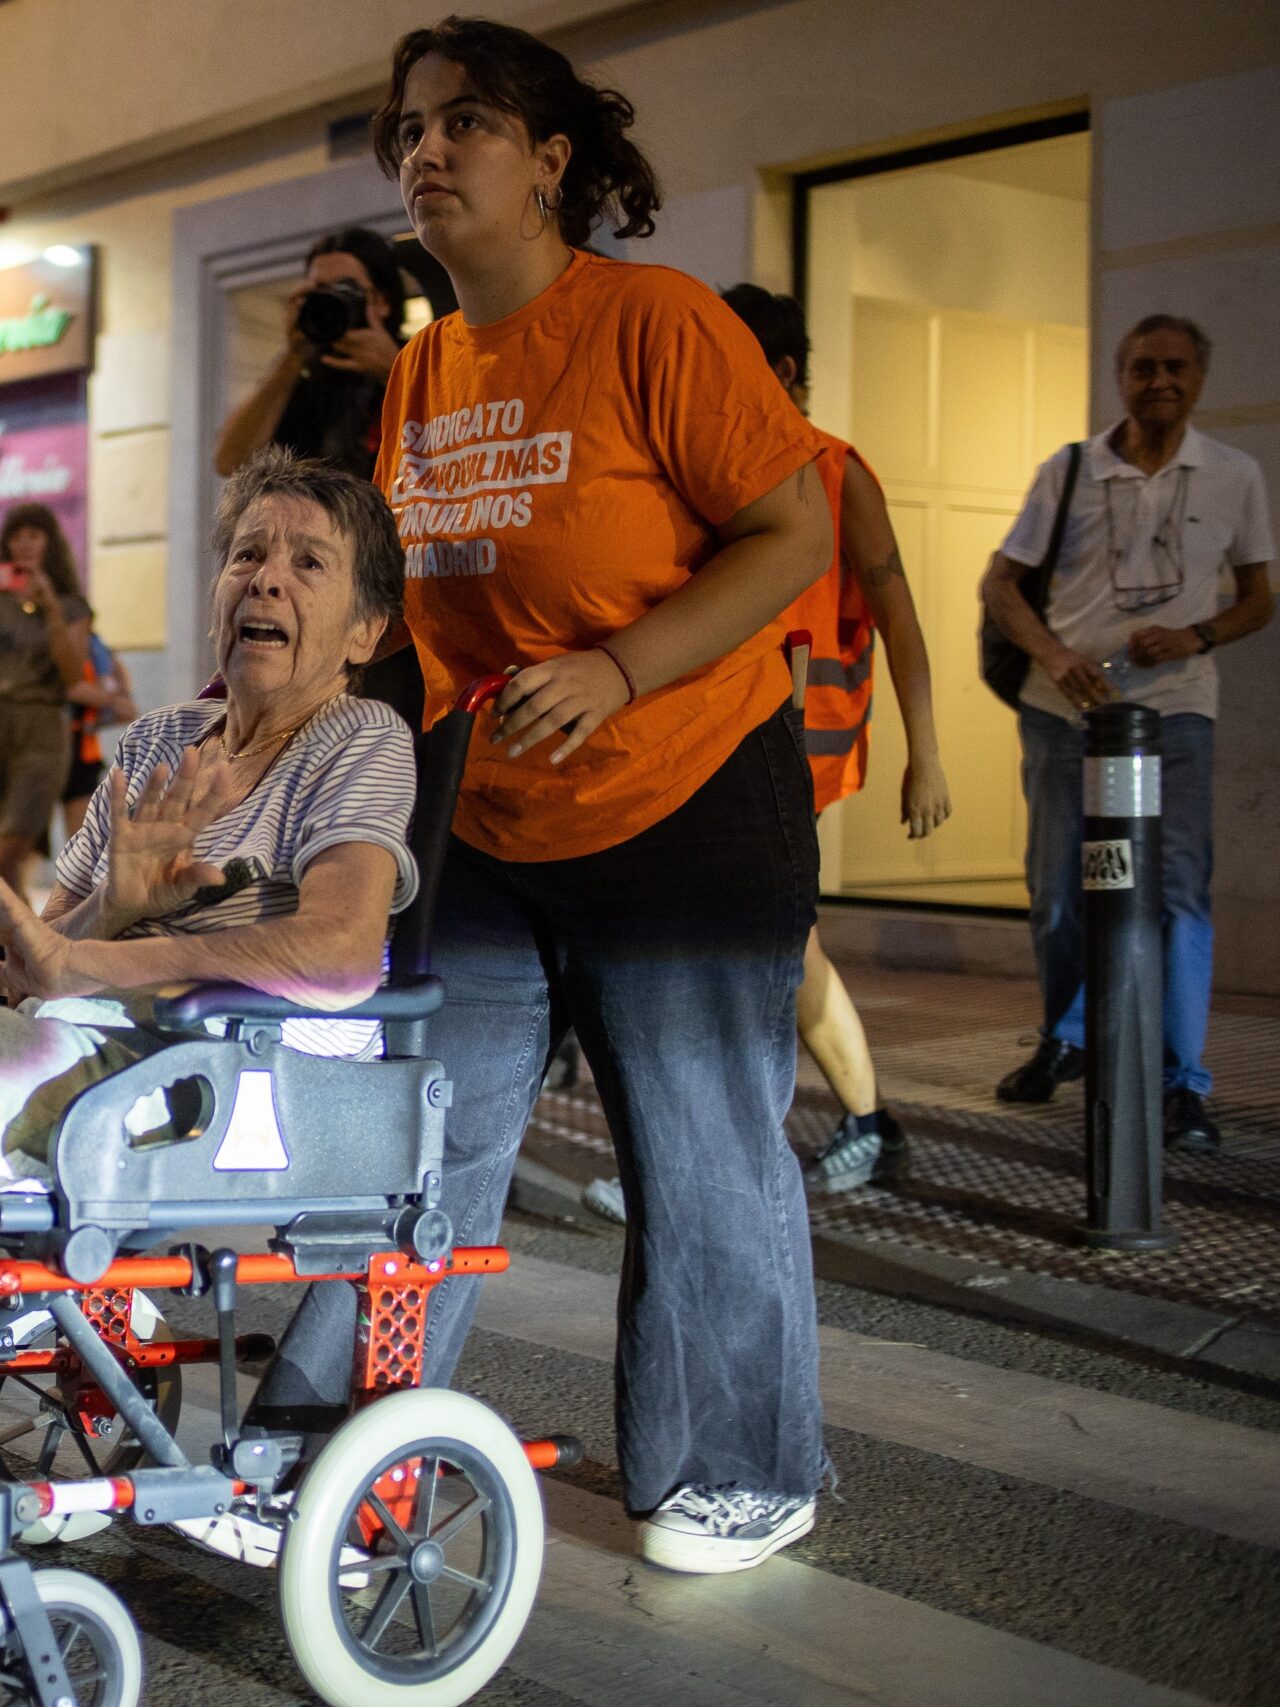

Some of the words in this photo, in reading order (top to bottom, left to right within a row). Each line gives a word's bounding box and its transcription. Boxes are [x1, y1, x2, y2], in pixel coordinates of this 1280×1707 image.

[401, 398, 525, 453] SINDICATO
[415, 440, 562, 495] INQUILINAS
[398, 491, 533, 540] INQUILINOS
[405, 538, 497, 579] MADRID
